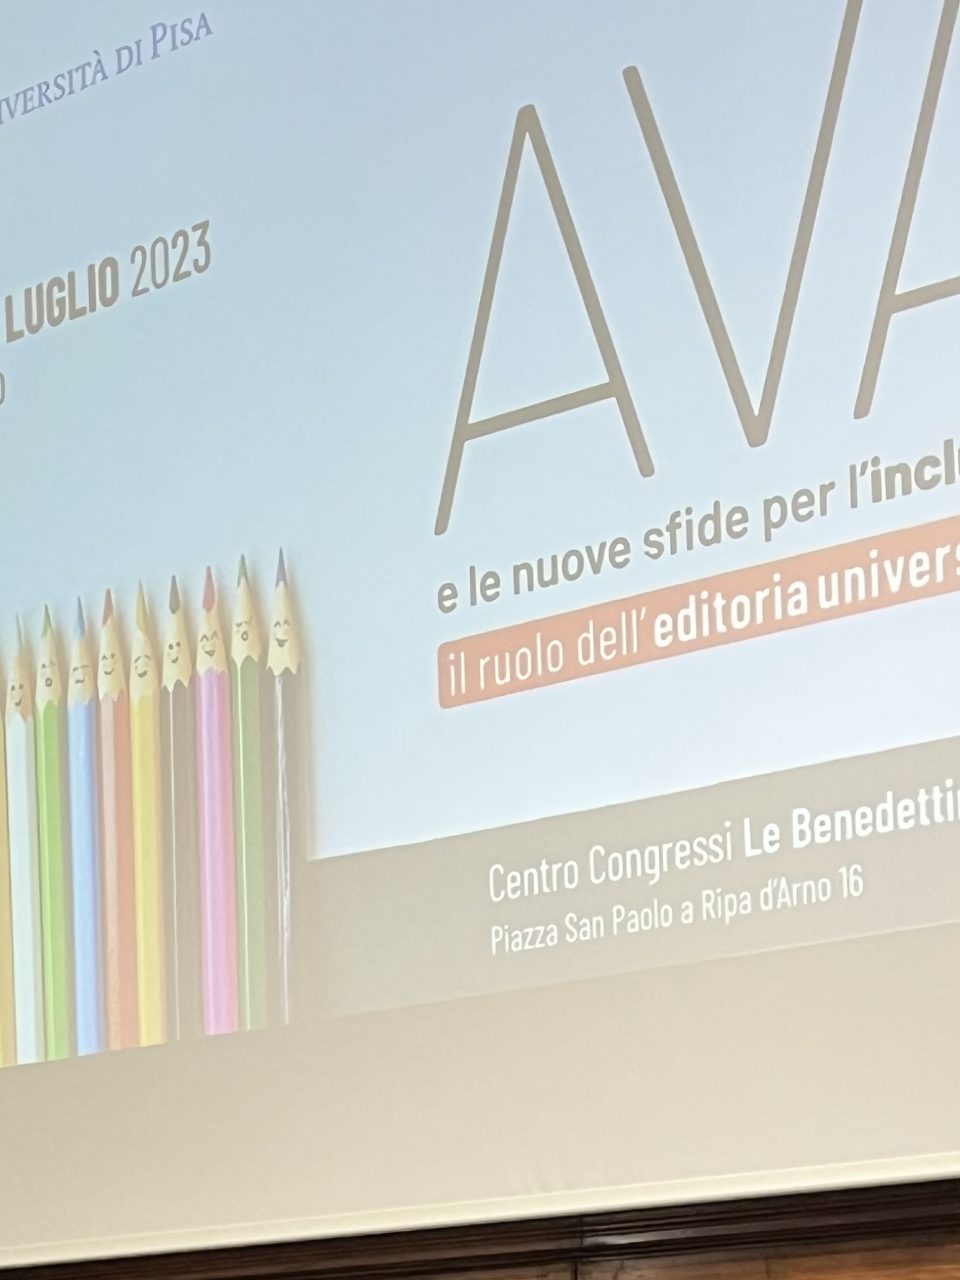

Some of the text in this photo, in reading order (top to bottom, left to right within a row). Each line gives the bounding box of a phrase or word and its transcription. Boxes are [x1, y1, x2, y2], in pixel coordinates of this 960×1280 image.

[5, 256, 119, 343] LUGLIO
[131, 220, 212, 297] 2023
[437, 438, 960, 613] e le nuove sfide per l'incl
[448, 652, 467, 696] il
[479, 631, 564, 689] ruolo
[818, 548, 960, 609] univers
[489, 778, 960, 902] Centro Congressi Le Benedetti
[491, 863, 864, 955] Piazza San Paolo a Ripa d'Arno 16
